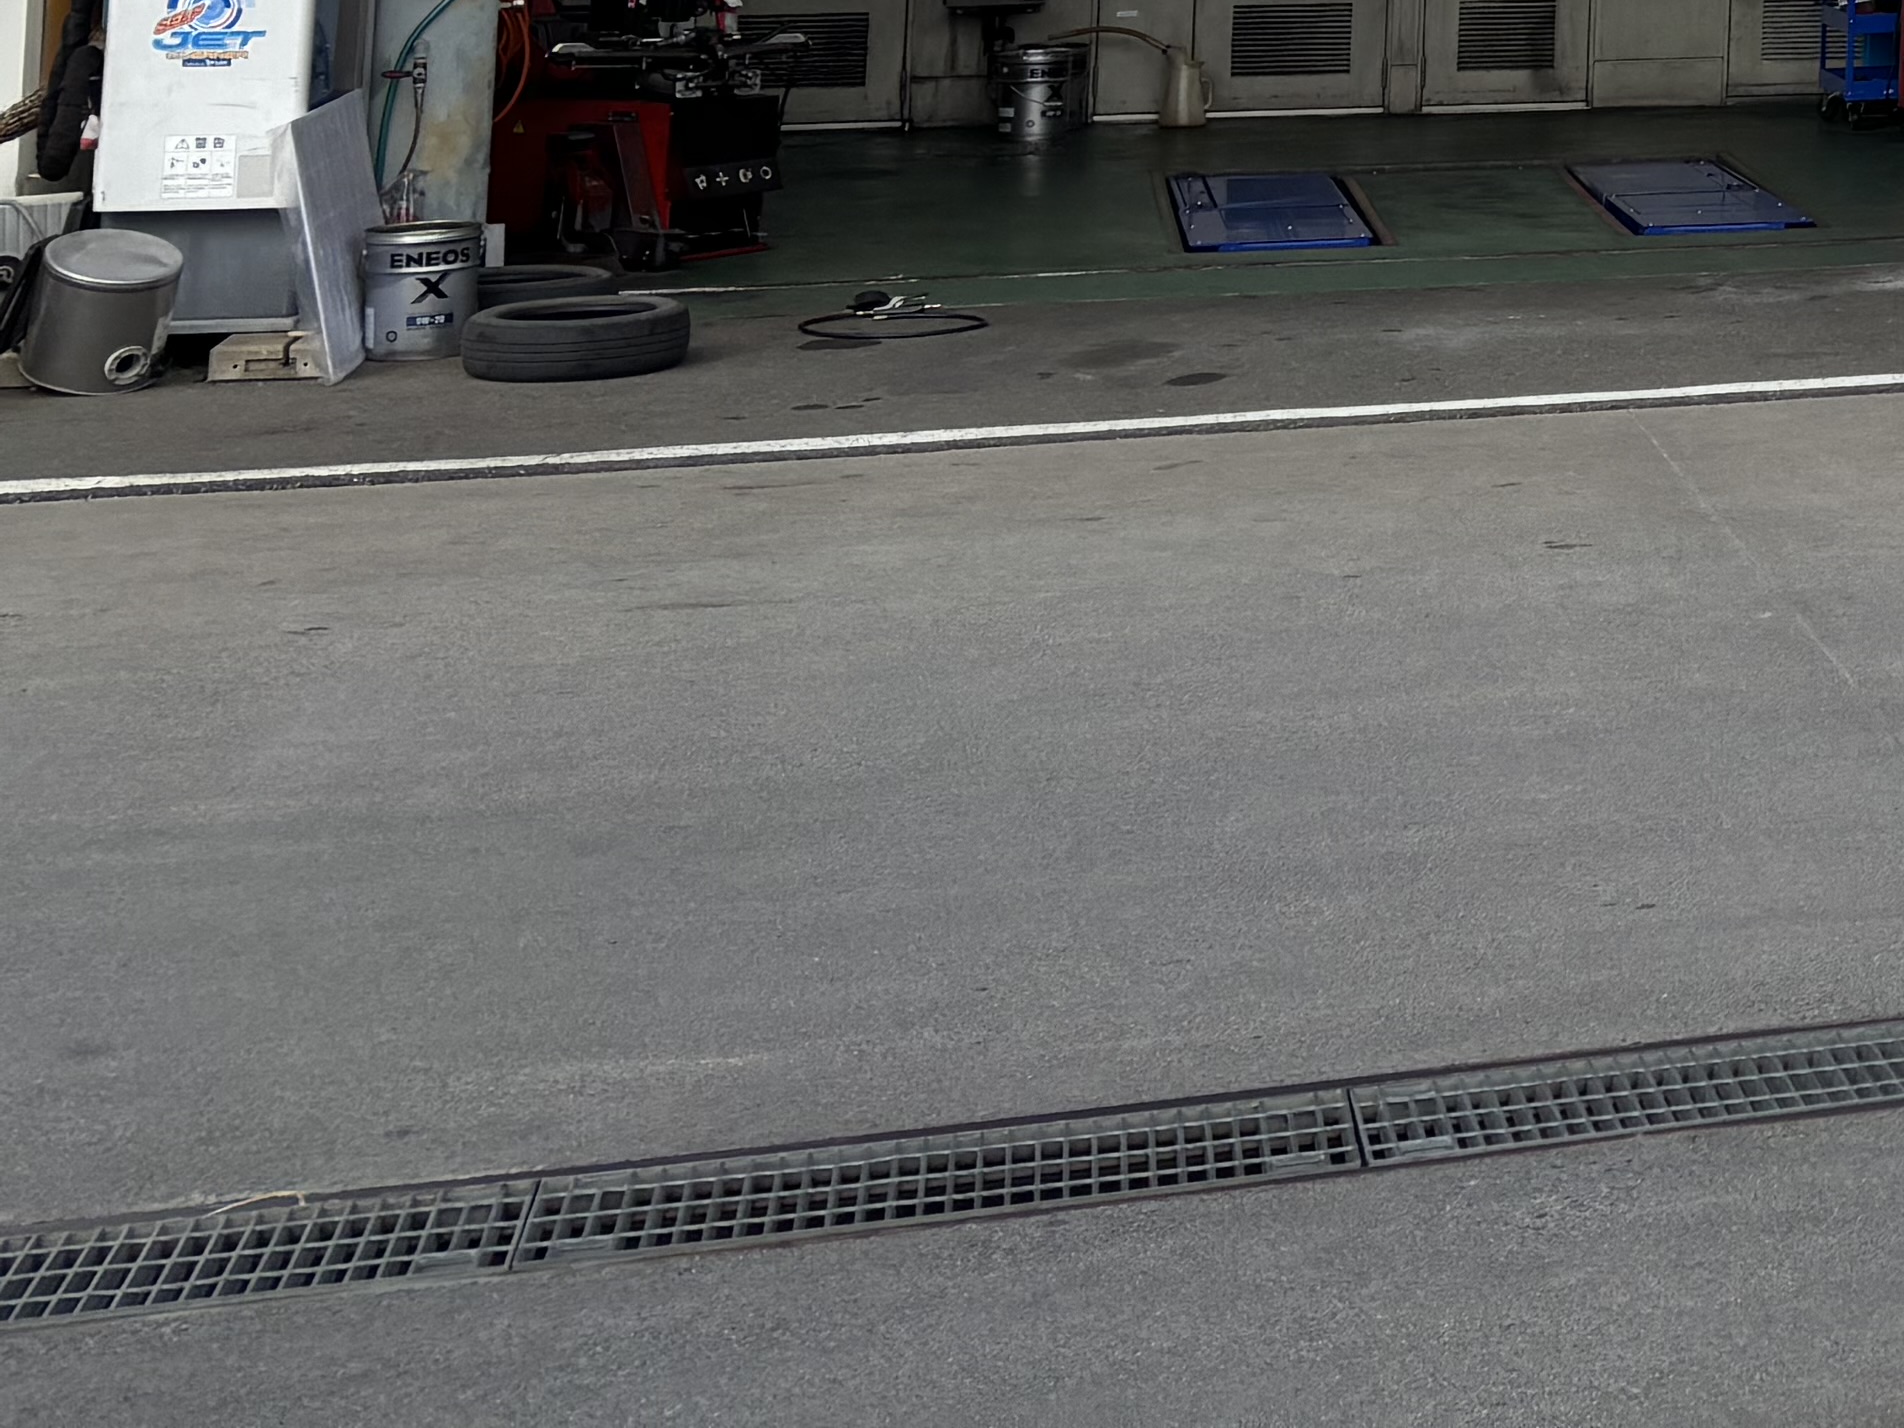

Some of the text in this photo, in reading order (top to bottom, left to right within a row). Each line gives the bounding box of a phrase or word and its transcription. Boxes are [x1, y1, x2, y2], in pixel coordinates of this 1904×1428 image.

[152, 30, 266, 51] JET
[390, 247, 470, 269] ENEOS
[410, 272, 451, 304] X
